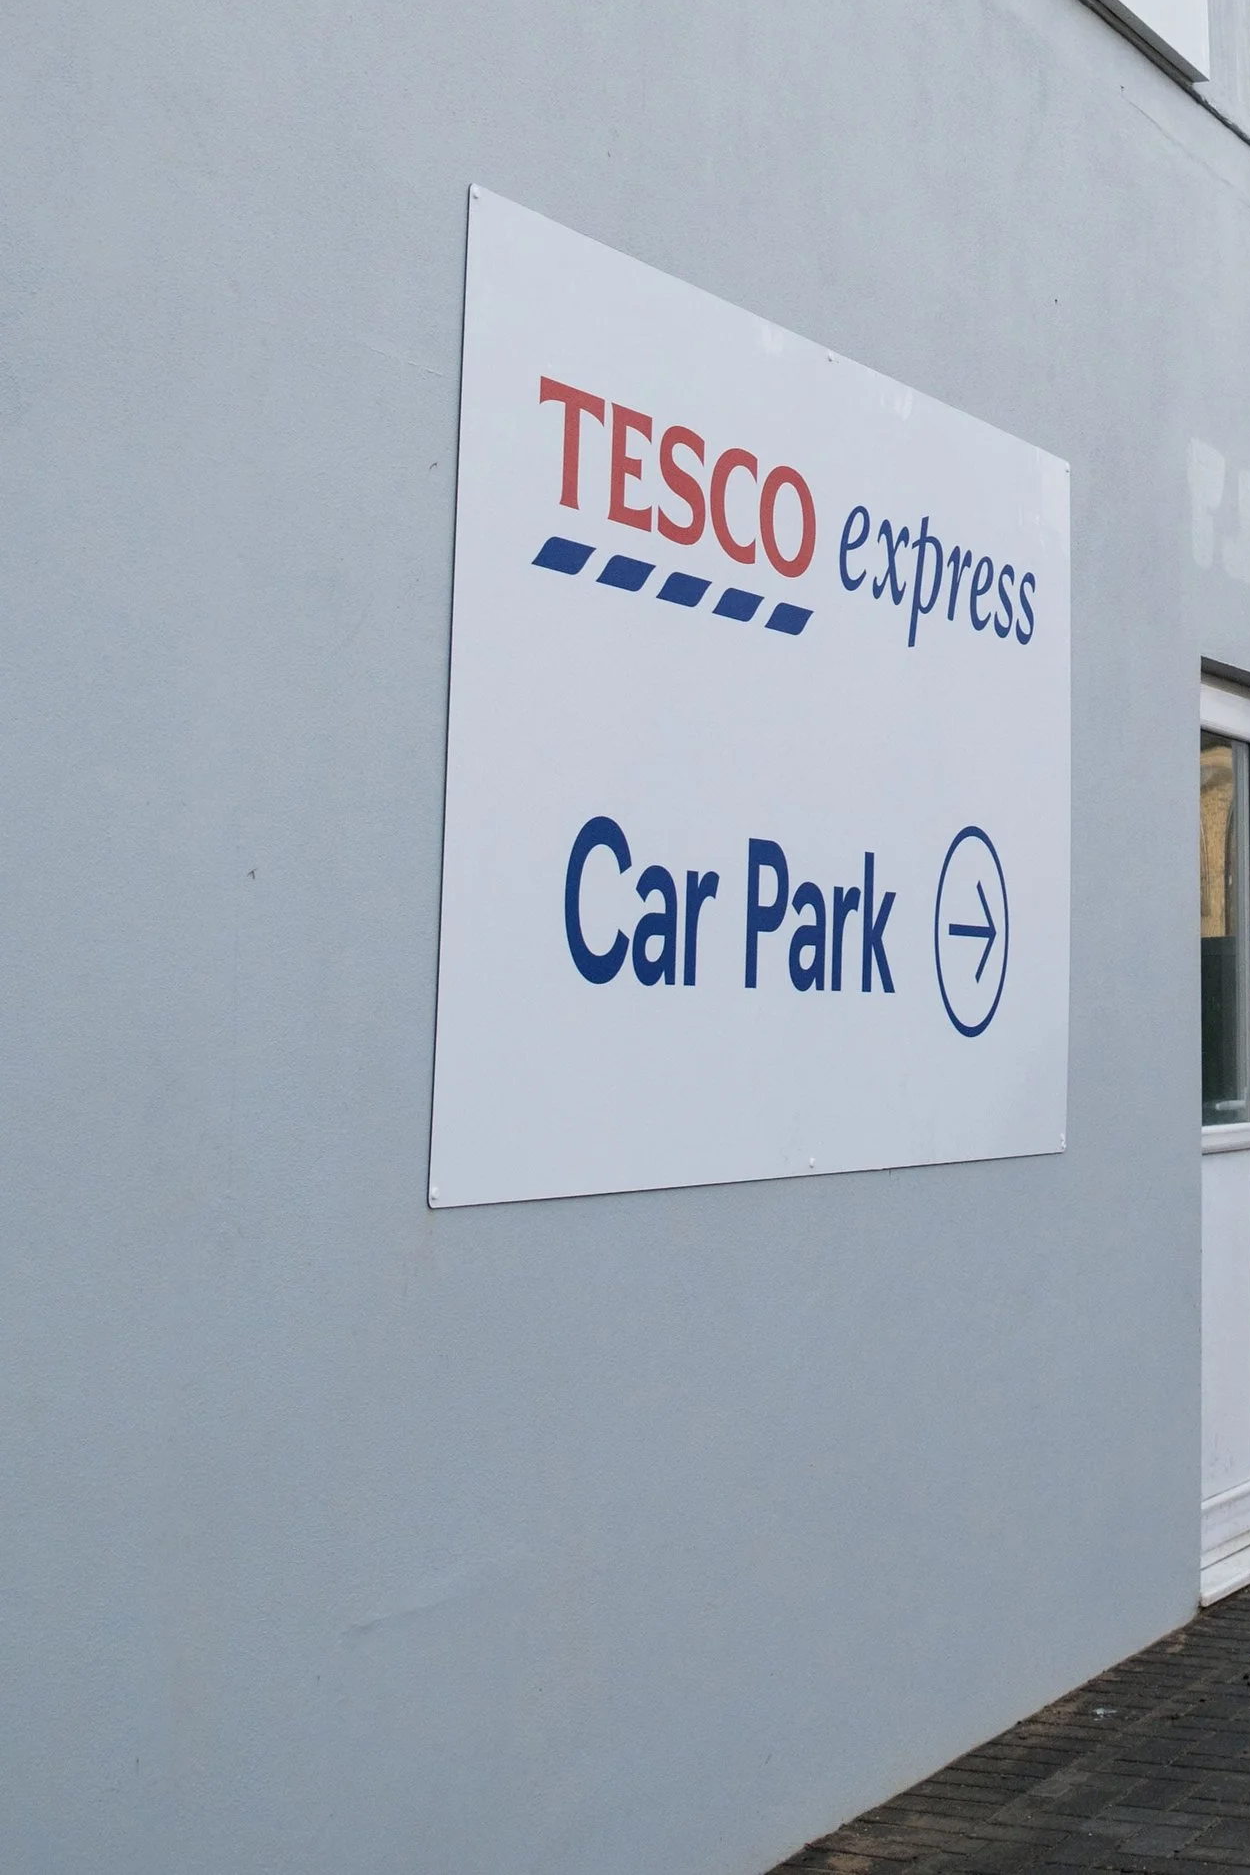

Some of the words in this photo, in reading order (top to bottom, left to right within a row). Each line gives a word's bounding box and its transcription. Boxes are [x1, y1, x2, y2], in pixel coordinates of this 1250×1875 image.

[540, 375, 816, 578] TESCO
[838, 505, 1036, 647] express
[564, 815, 719, 985] Car
[745, 838, 896, 994] Park
